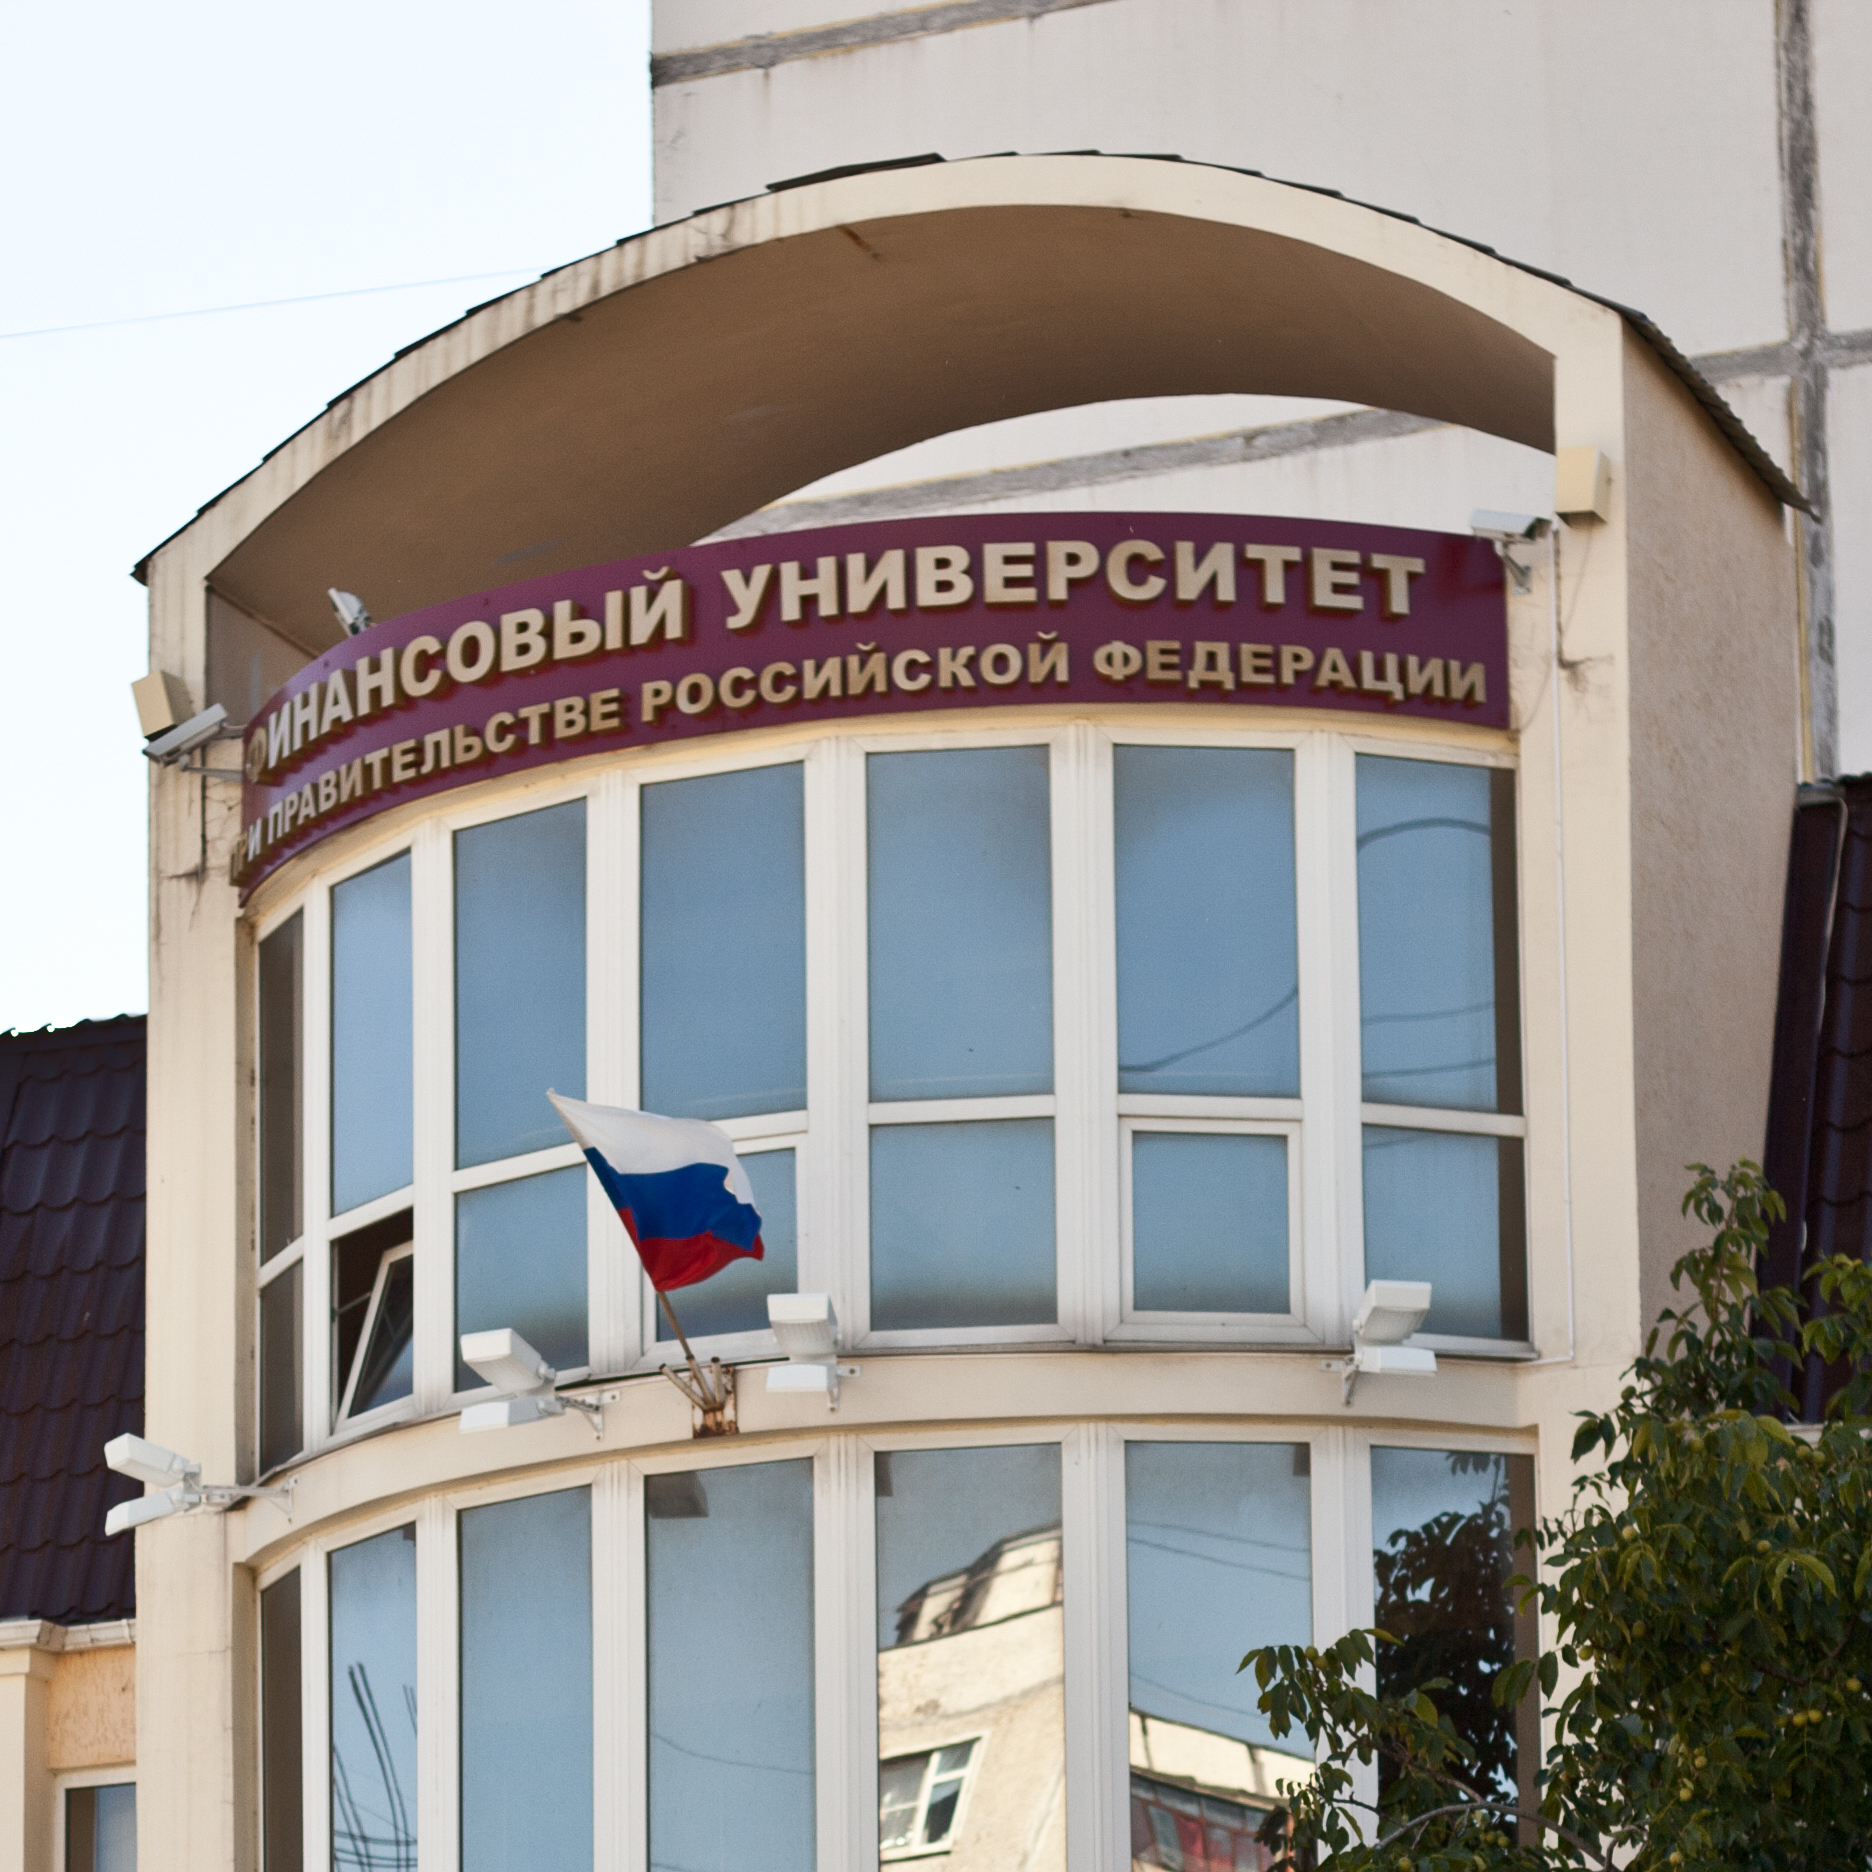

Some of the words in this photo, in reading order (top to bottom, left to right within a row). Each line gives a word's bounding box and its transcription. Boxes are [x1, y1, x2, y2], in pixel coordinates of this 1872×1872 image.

[245, 566, 684, 784] ФИНАНСОВЫЙ
[720, 539, 1427, 630] УНИВЕРСИТЕТ
[266, 688, 621, 845] ПРАВИТЕЛЬСТВЕ
[640, 631, 1071, 722] РОССИЙСКОЙ
[1092, 639, 1487, 704] ФЕДЕРАЦИИ
